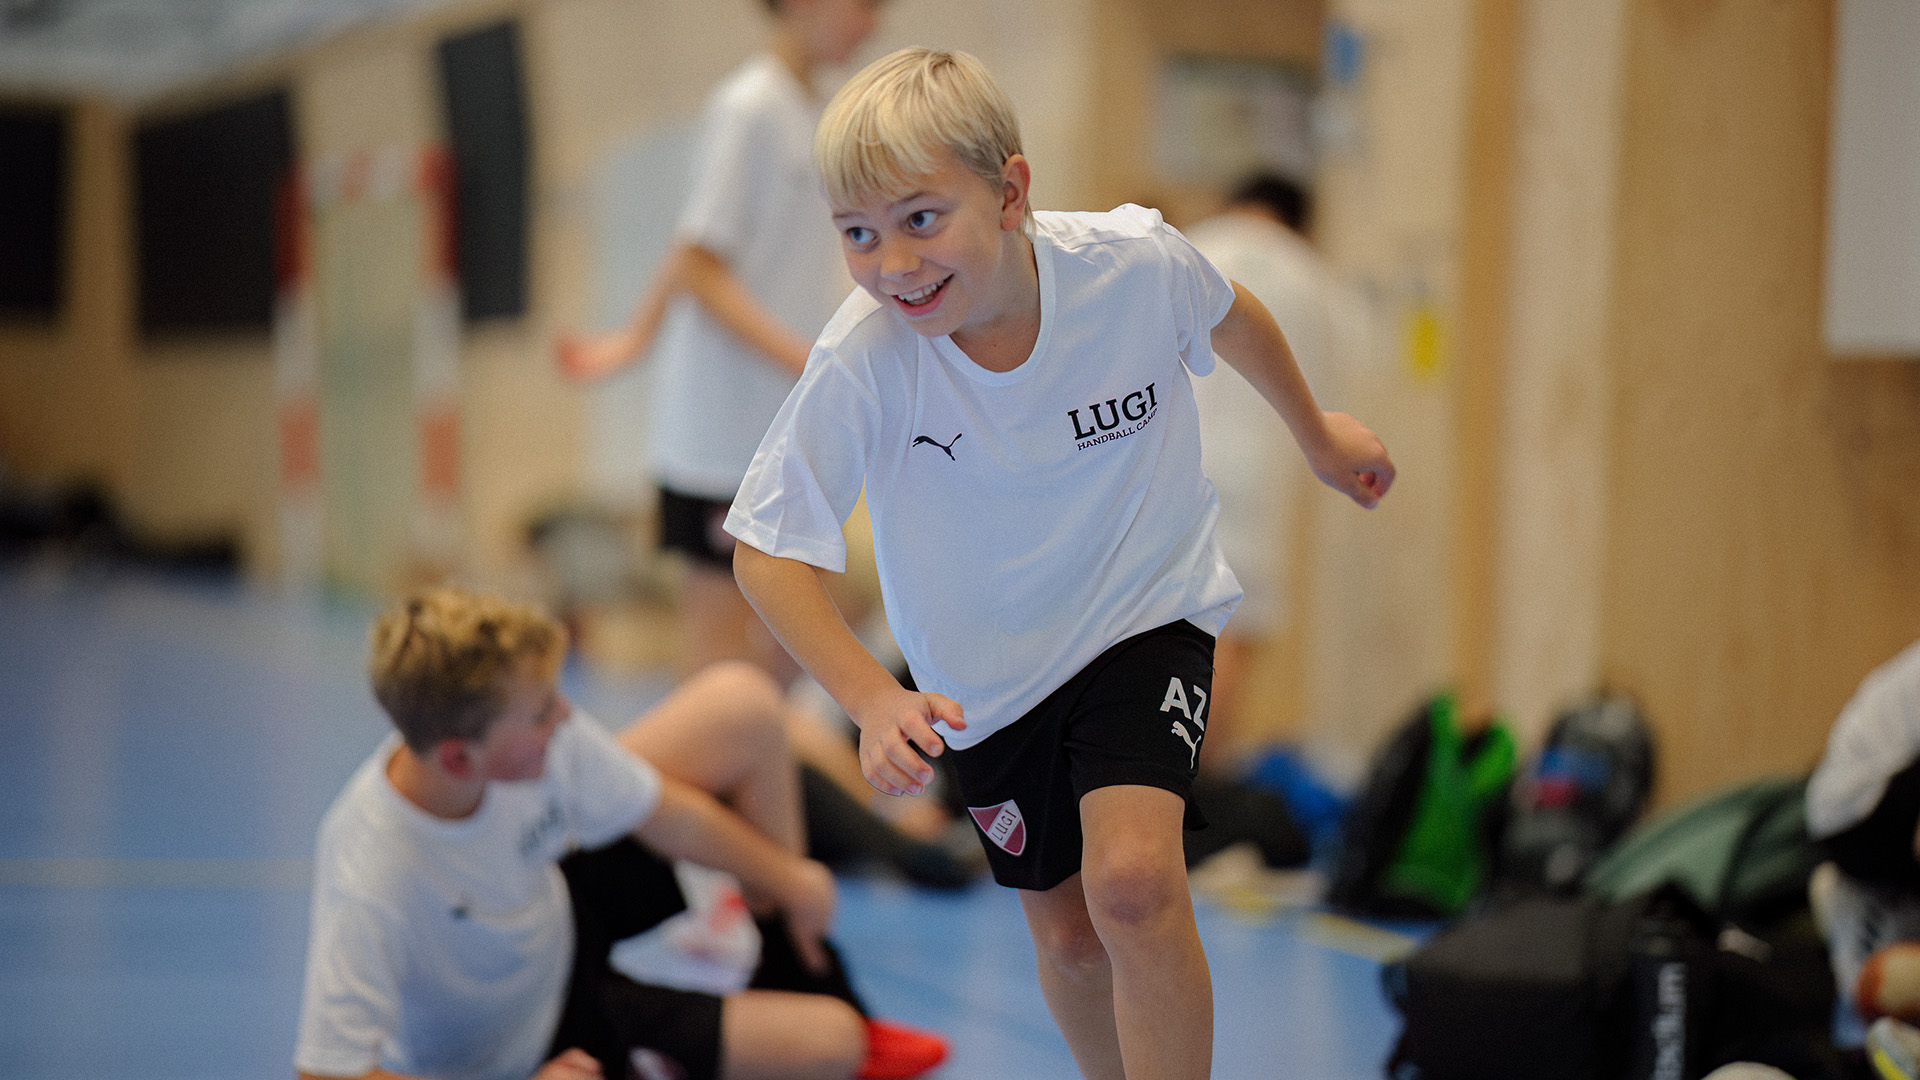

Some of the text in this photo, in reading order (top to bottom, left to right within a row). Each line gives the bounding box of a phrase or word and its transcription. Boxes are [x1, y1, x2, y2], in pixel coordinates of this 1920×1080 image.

[1066, 381, 1158, 441] LUGI
[1077, 426, 1136, 451] HANDBALL
[1159, 676, 1207, 732] AZ
[991, 809, 1017, 841] LUGI
